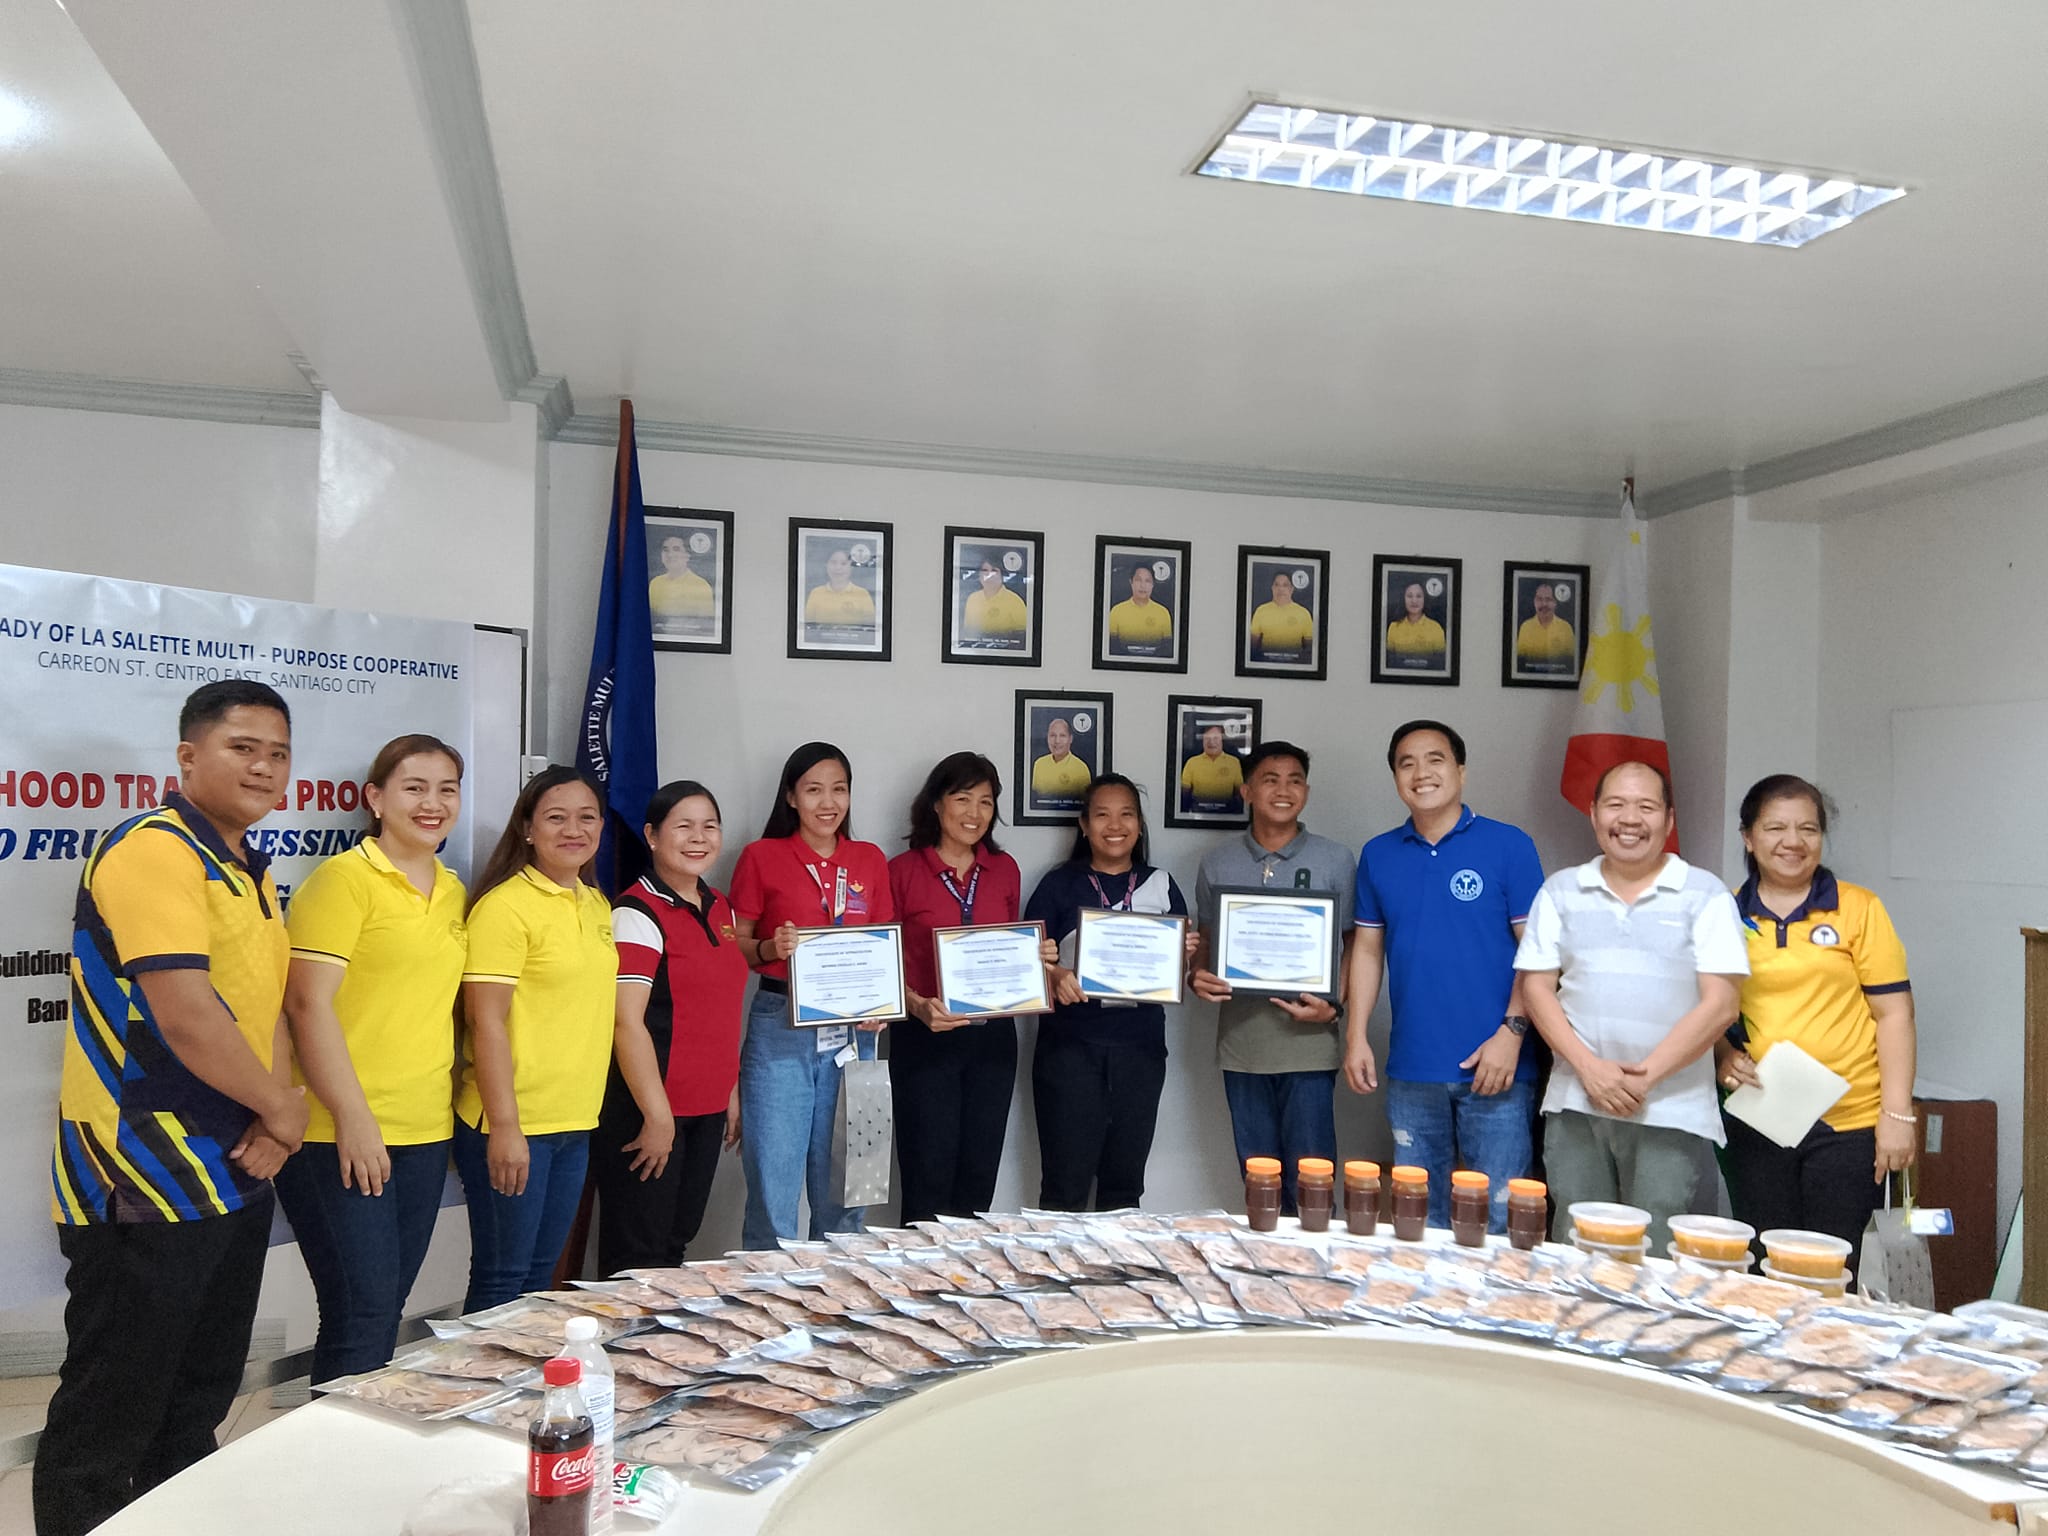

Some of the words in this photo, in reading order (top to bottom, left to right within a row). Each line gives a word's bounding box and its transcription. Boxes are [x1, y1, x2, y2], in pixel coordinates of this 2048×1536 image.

[38, 651, 120, 674] CARREON
[125, 660, 150, 677] ST.
[155, 662, 219, 682] CENTRO
[270, 671, 343, 693] SANTIAGO
[347, 679, 377, 695] CITY
[49, 623, 75, 644] OF
[82, 627, 106, 648] LA
[112, 630, 191, 656] SALETTE
[197, 639, 254, 661] MULTI
[272, 647, 348, 670] PURPOSE
[353, 655, 459, 680] COOPERATIVE
[587, 711, 610, 782] SALETTE
[0, 949, 72, 978] uilding
